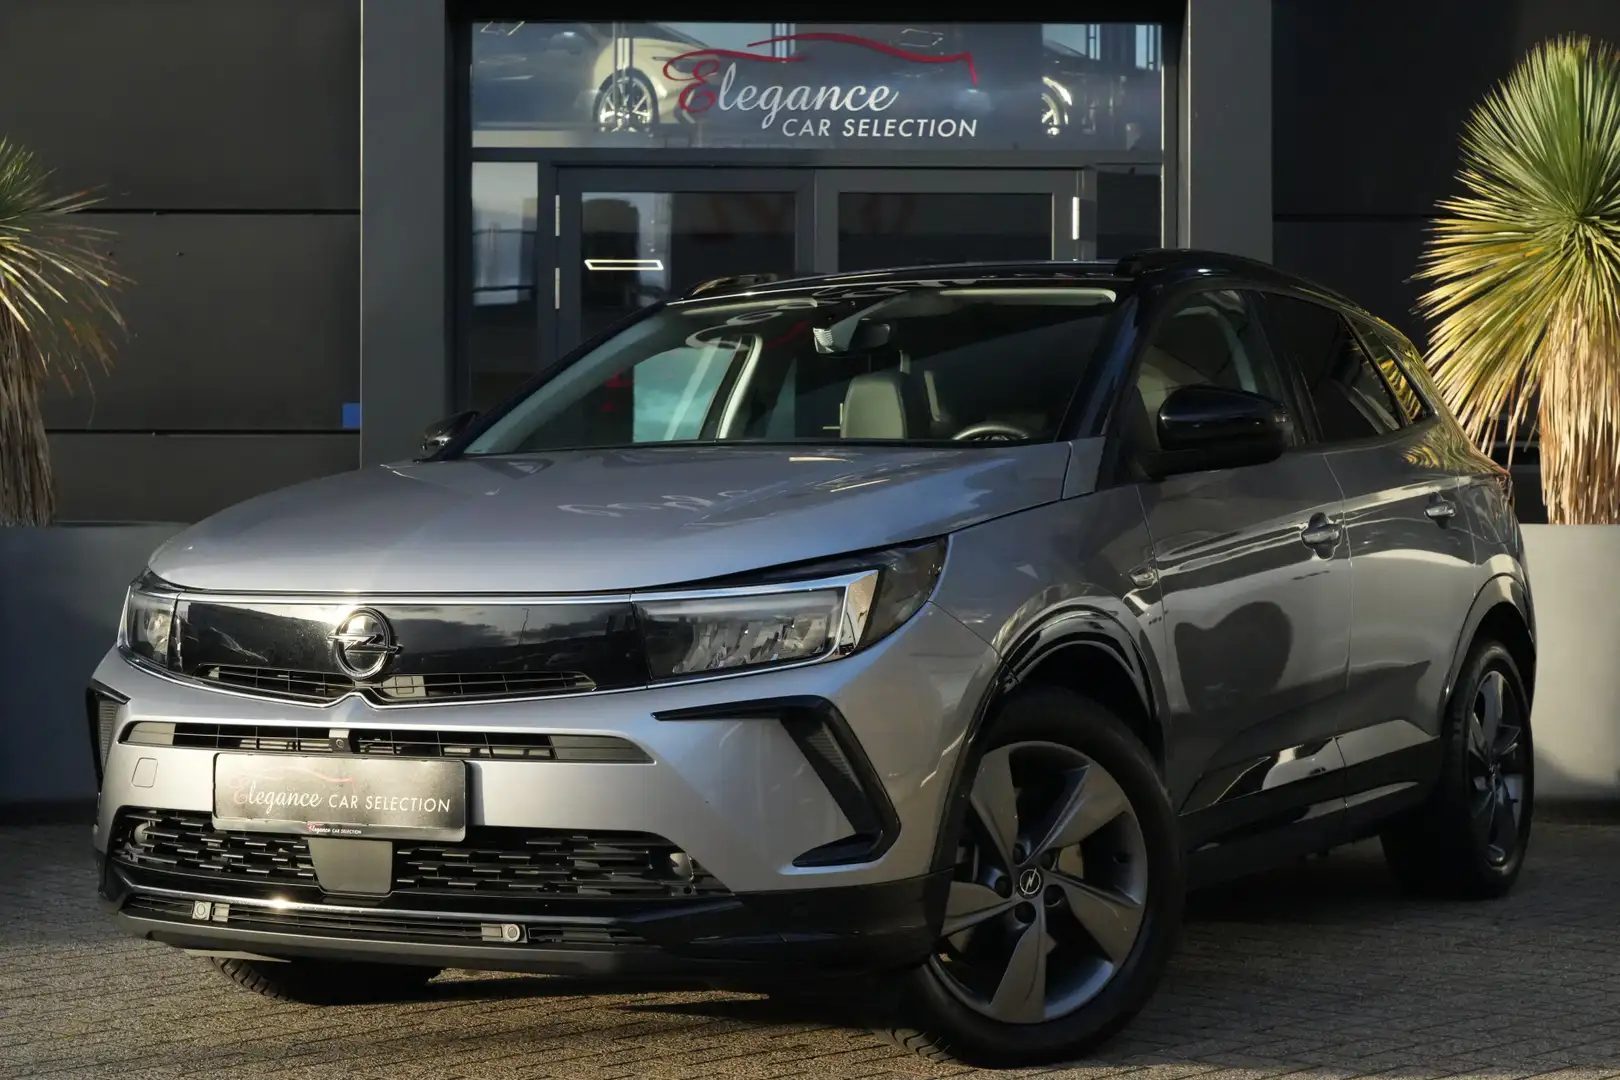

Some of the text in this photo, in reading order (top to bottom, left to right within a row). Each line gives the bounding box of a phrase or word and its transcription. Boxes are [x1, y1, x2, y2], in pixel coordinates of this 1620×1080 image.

[670, 58, 899, 129] Elegance
[782, 118, 978, 138] CAR SELECTION
[232, 777, 451, 815] Elegance CAR SELECTION
